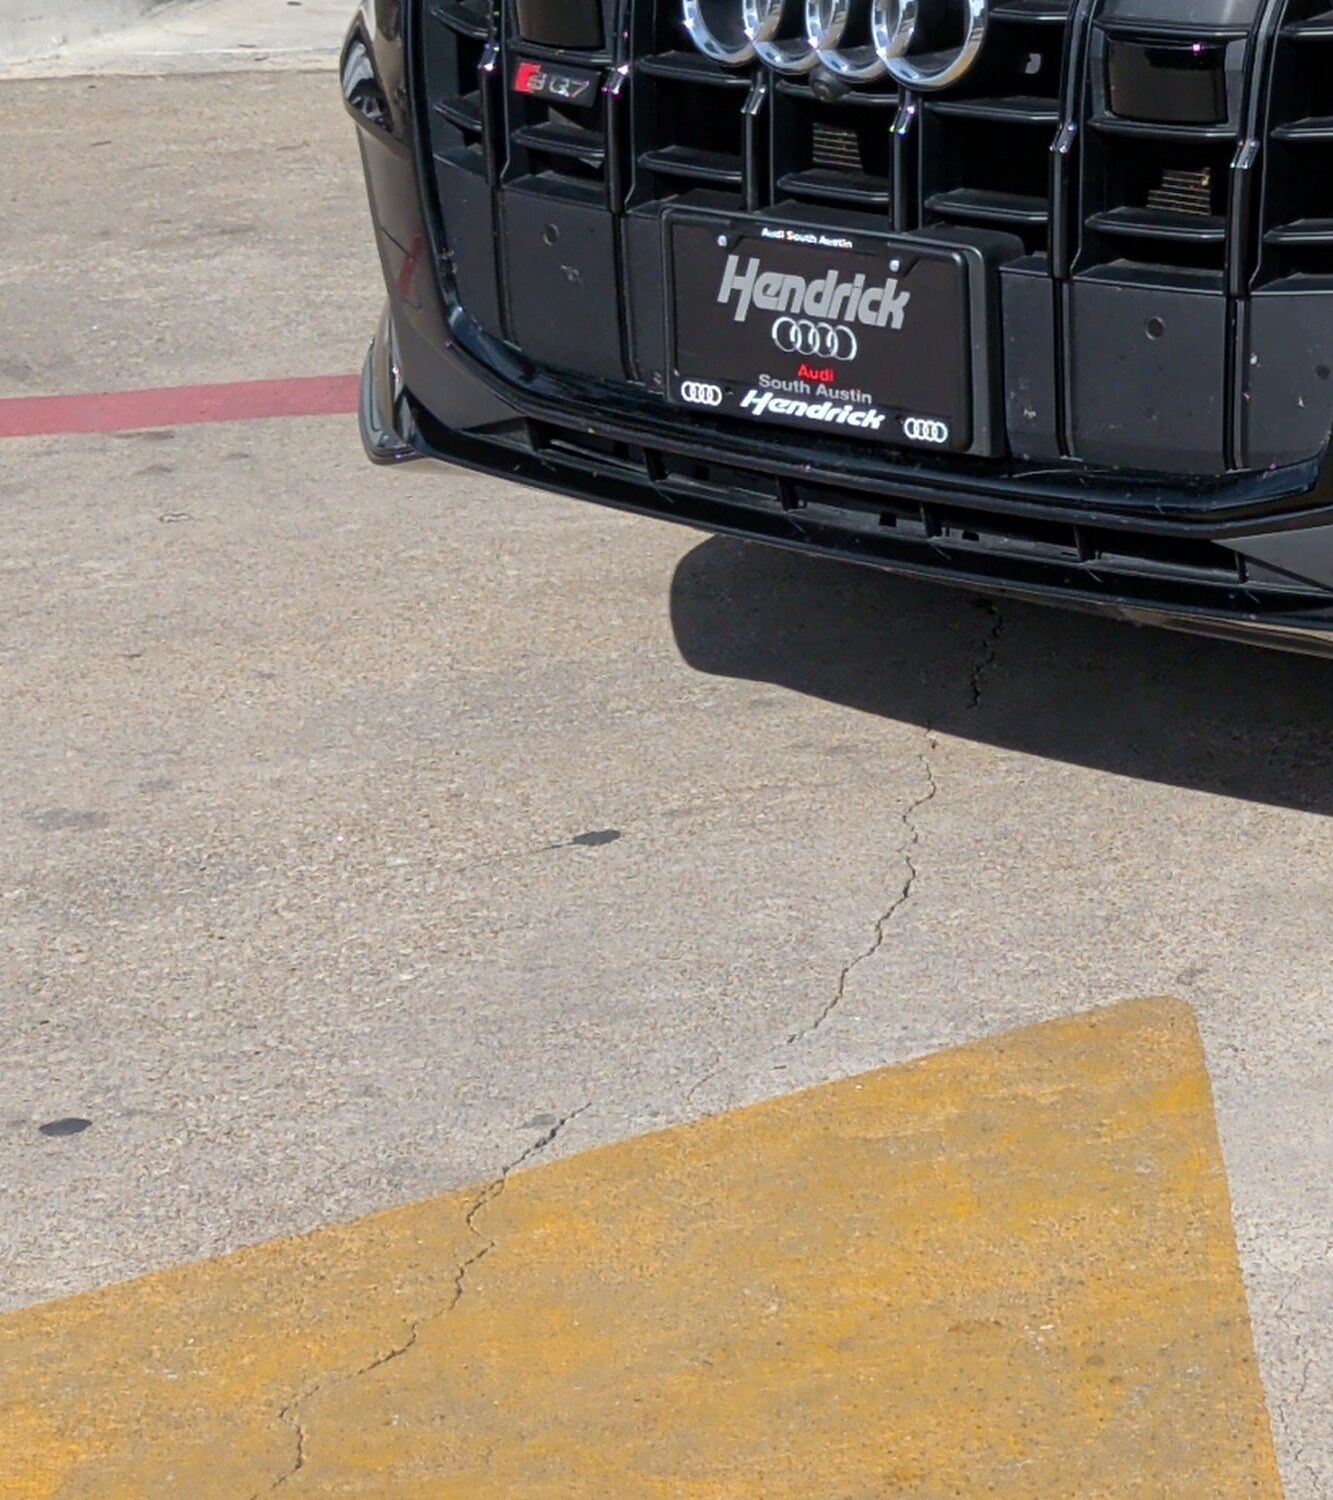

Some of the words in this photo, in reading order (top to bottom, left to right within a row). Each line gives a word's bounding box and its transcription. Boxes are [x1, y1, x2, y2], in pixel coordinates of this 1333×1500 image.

[761, 227, 785, 239] Audi
[786, 230, 817, 244] South
[819, 235, 853, 249] Austin
[717, 254, 911, 329] Hendrick
[798, 365, 834, 382] Audi
[758, 374, 811, 396] South
[815, 385, 873, 405] Austin
[740, 389, 886, 430] Hendrick
